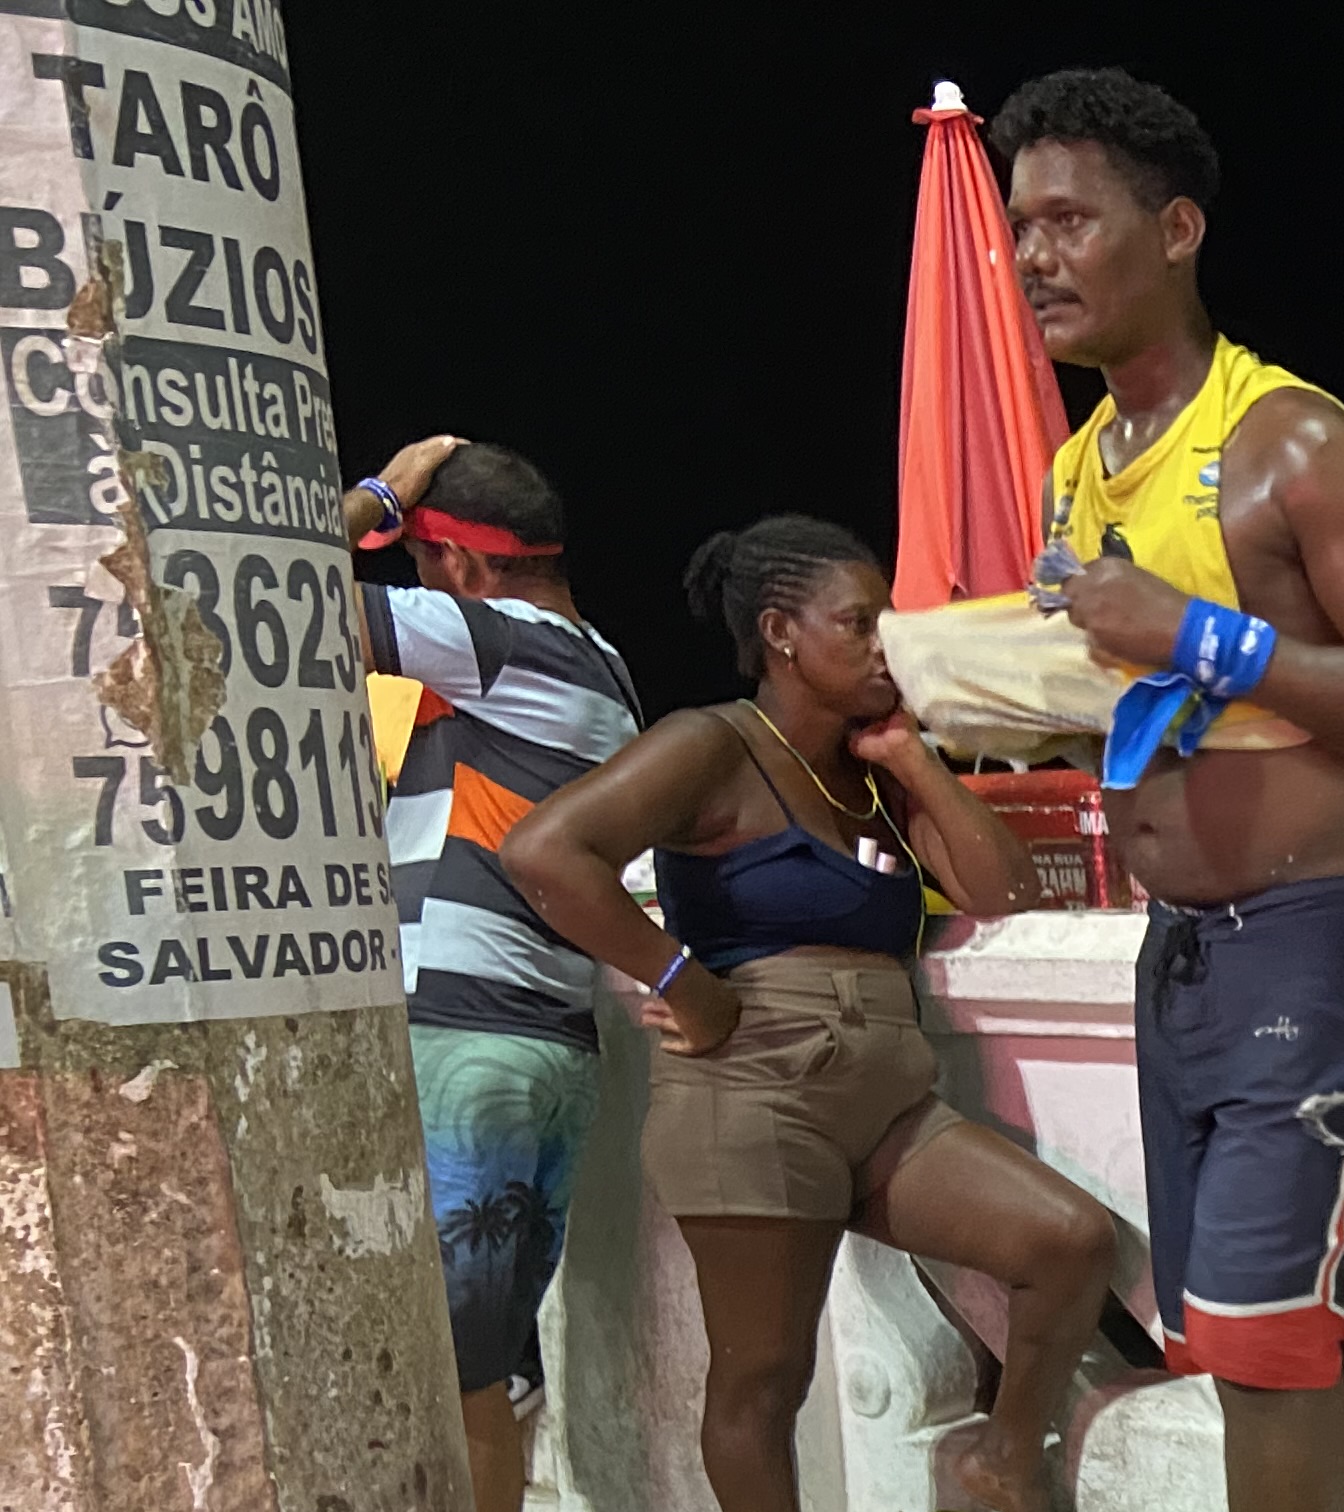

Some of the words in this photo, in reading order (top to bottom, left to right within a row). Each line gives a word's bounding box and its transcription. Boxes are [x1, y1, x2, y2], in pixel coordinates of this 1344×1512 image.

[32, 52, 281, 202] TARÔ
[124, 864, 311, 915] FEIRA
[324, 864, 371, 909] DE
[99, 929, 390, 987] SALVADOR
